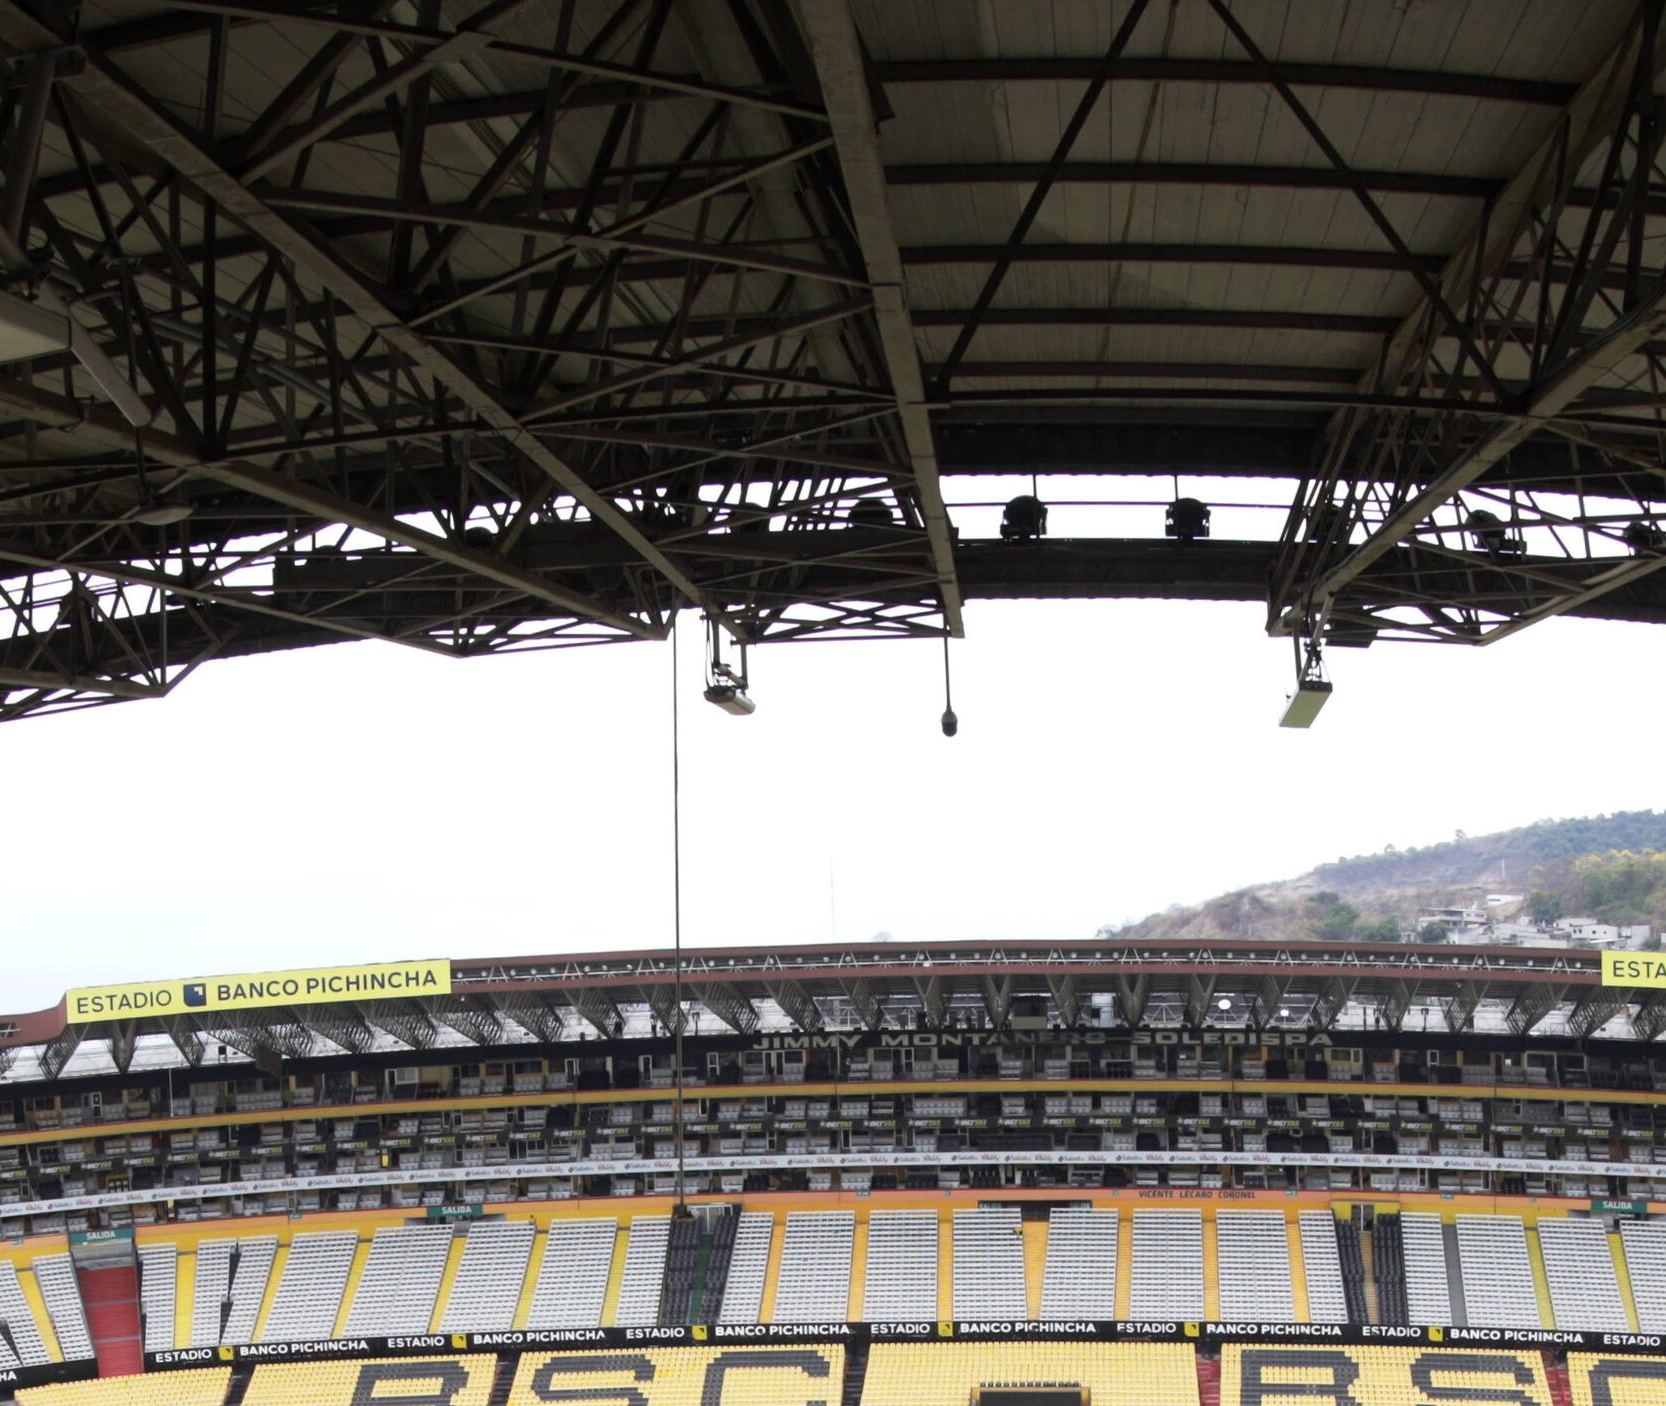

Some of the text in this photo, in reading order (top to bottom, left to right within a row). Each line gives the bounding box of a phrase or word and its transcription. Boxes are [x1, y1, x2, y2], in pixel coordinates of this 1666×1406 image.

[76, 968, 437, 1014] ESTADIO BANCO PICHINCHA
[1138, 1190, 1256, 1199] VICENTE LECARO CORONEL
[441, 1205, 472, 1215] SALIDA
[1602, 1201, 1632, 1211] SALIDA
[86, 1230, 117, 1240] SALIDA
[626, 1324, 850, 1339] ESTADIO BANCO PICHINCHA
[870, 1322, 1096, 1334] ESTADIO BANCO PICHINCHA
[1117, 1322, 1342, 1336] ESTADIO BANCO PICHINCHA
[1362, 1326, 1583, 1343] ESTADIO BANCO PICHINCHA
[387, 1329, 605, 1348] ESTADIO BANCO PICHINCHA
[1603, 1334, 1661, 1347] ESTADIO
[155, 1338, 368, 1363] ESTADIO BANCO PICHINCHA
